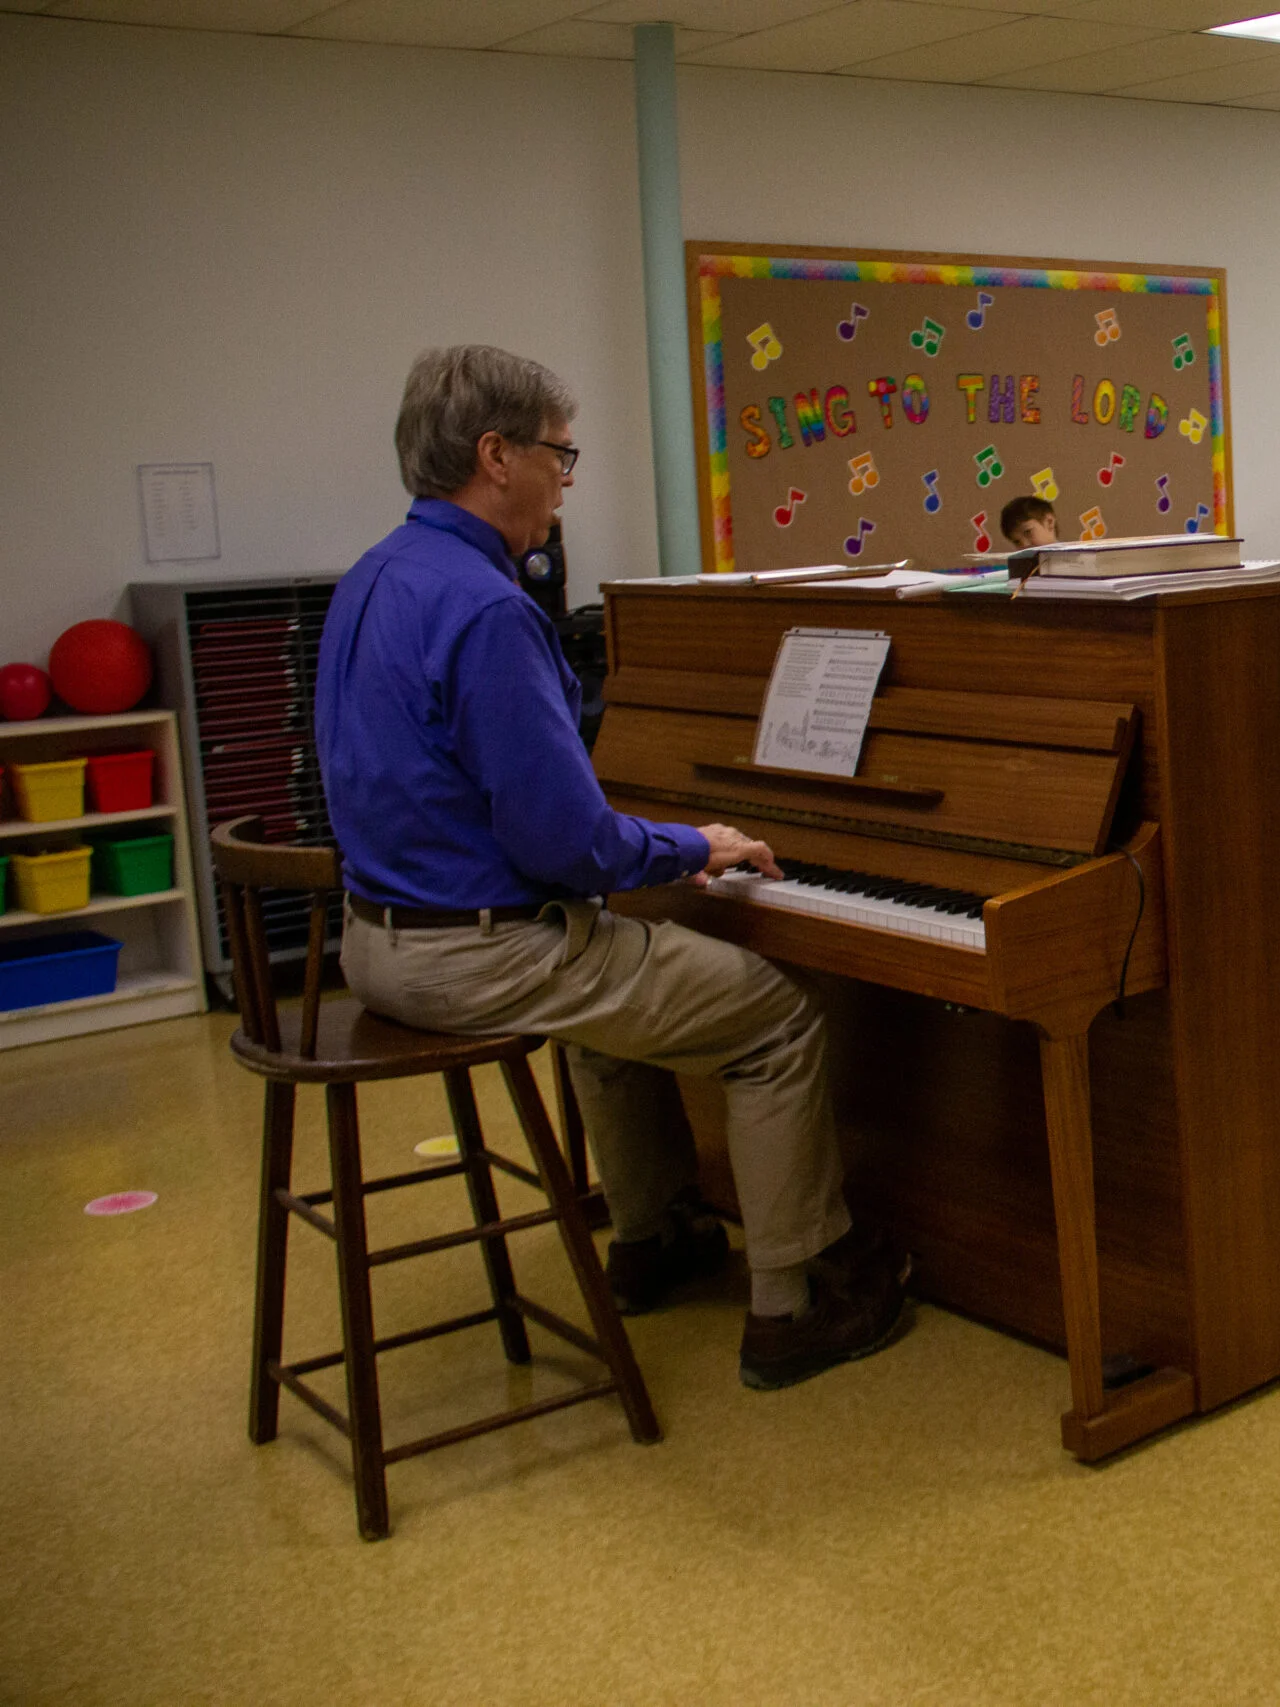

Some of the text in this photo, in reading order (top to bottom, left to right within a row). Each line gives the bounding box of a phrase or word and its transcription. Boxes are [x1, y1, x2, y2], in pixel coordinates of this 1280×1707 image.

[740, 374, 1168, 458] SING TO THE LORD
